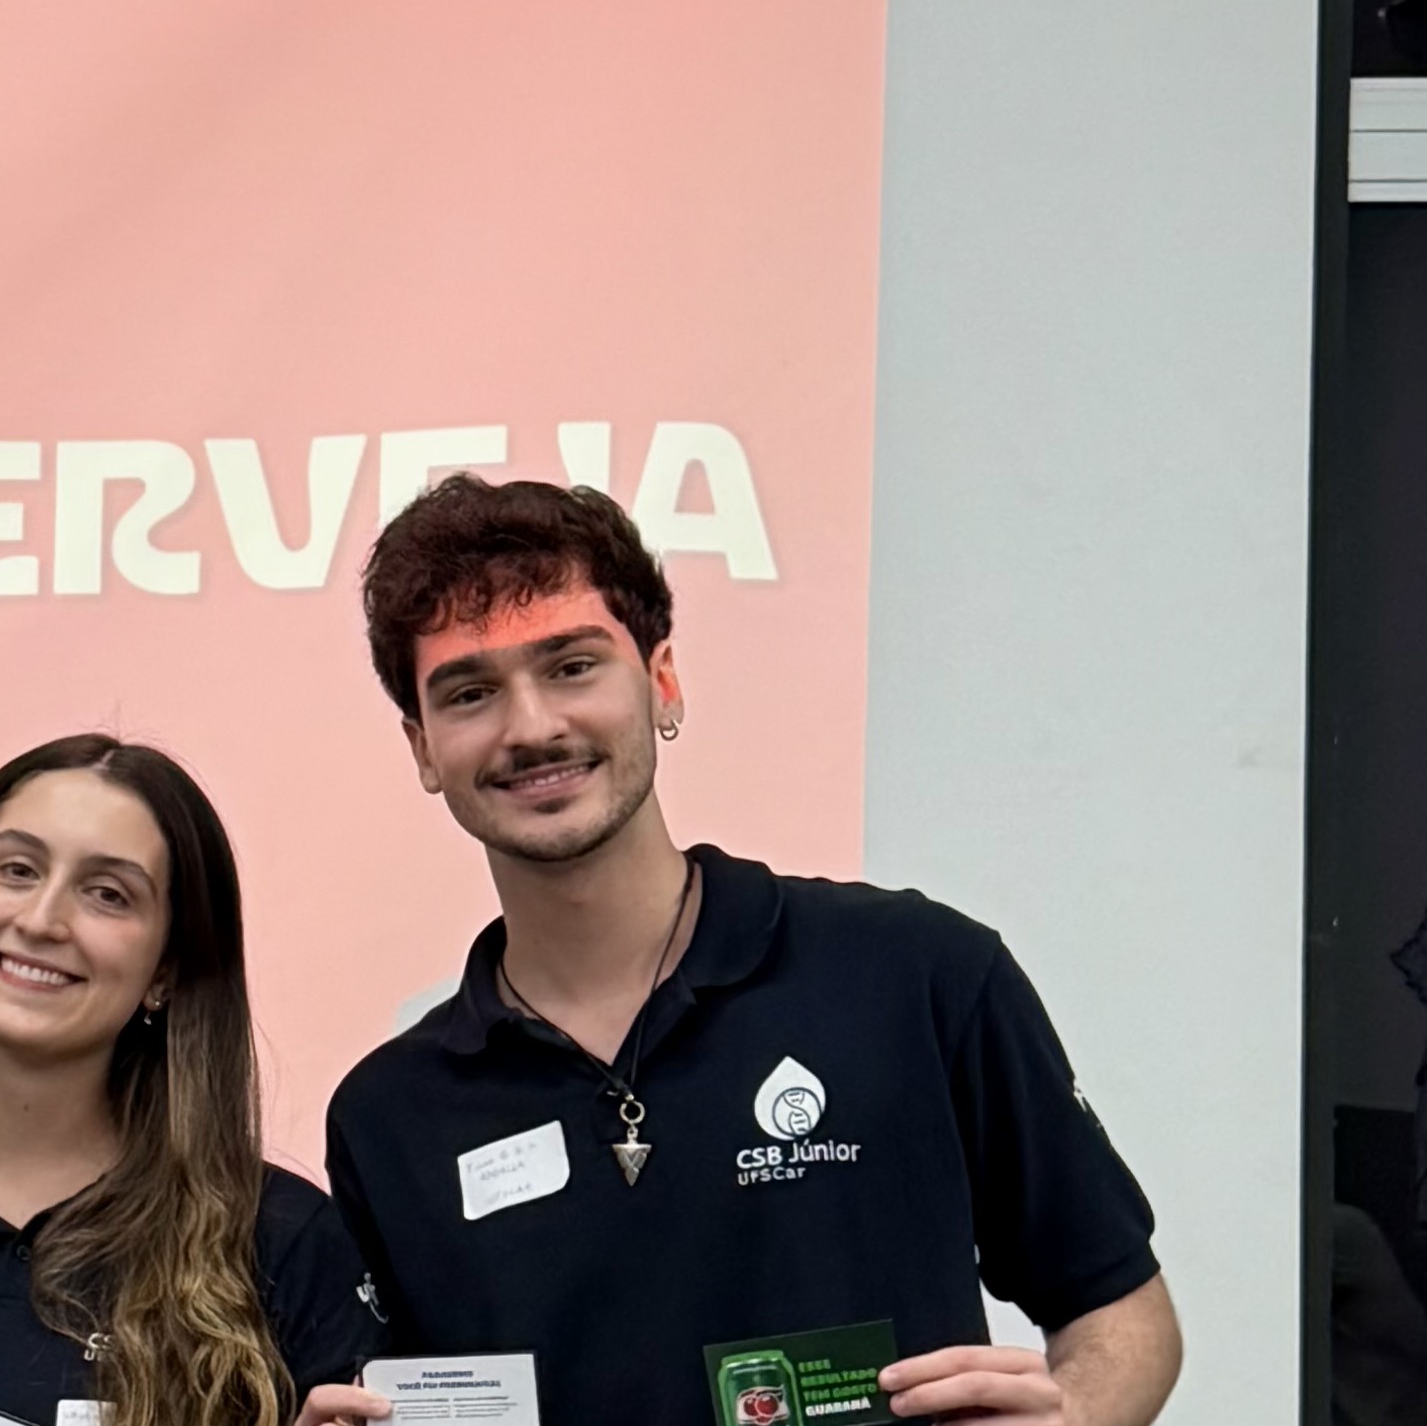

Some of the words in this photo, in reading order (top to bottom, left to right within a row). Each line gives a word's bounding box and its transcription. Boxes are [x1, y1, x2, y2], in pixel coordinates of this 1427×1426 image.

[736, 1145, 782, 1169] CSB
[788, 1138, 861, 1163] Júnior
[737, 1166, 806, 1186] UFSCar
